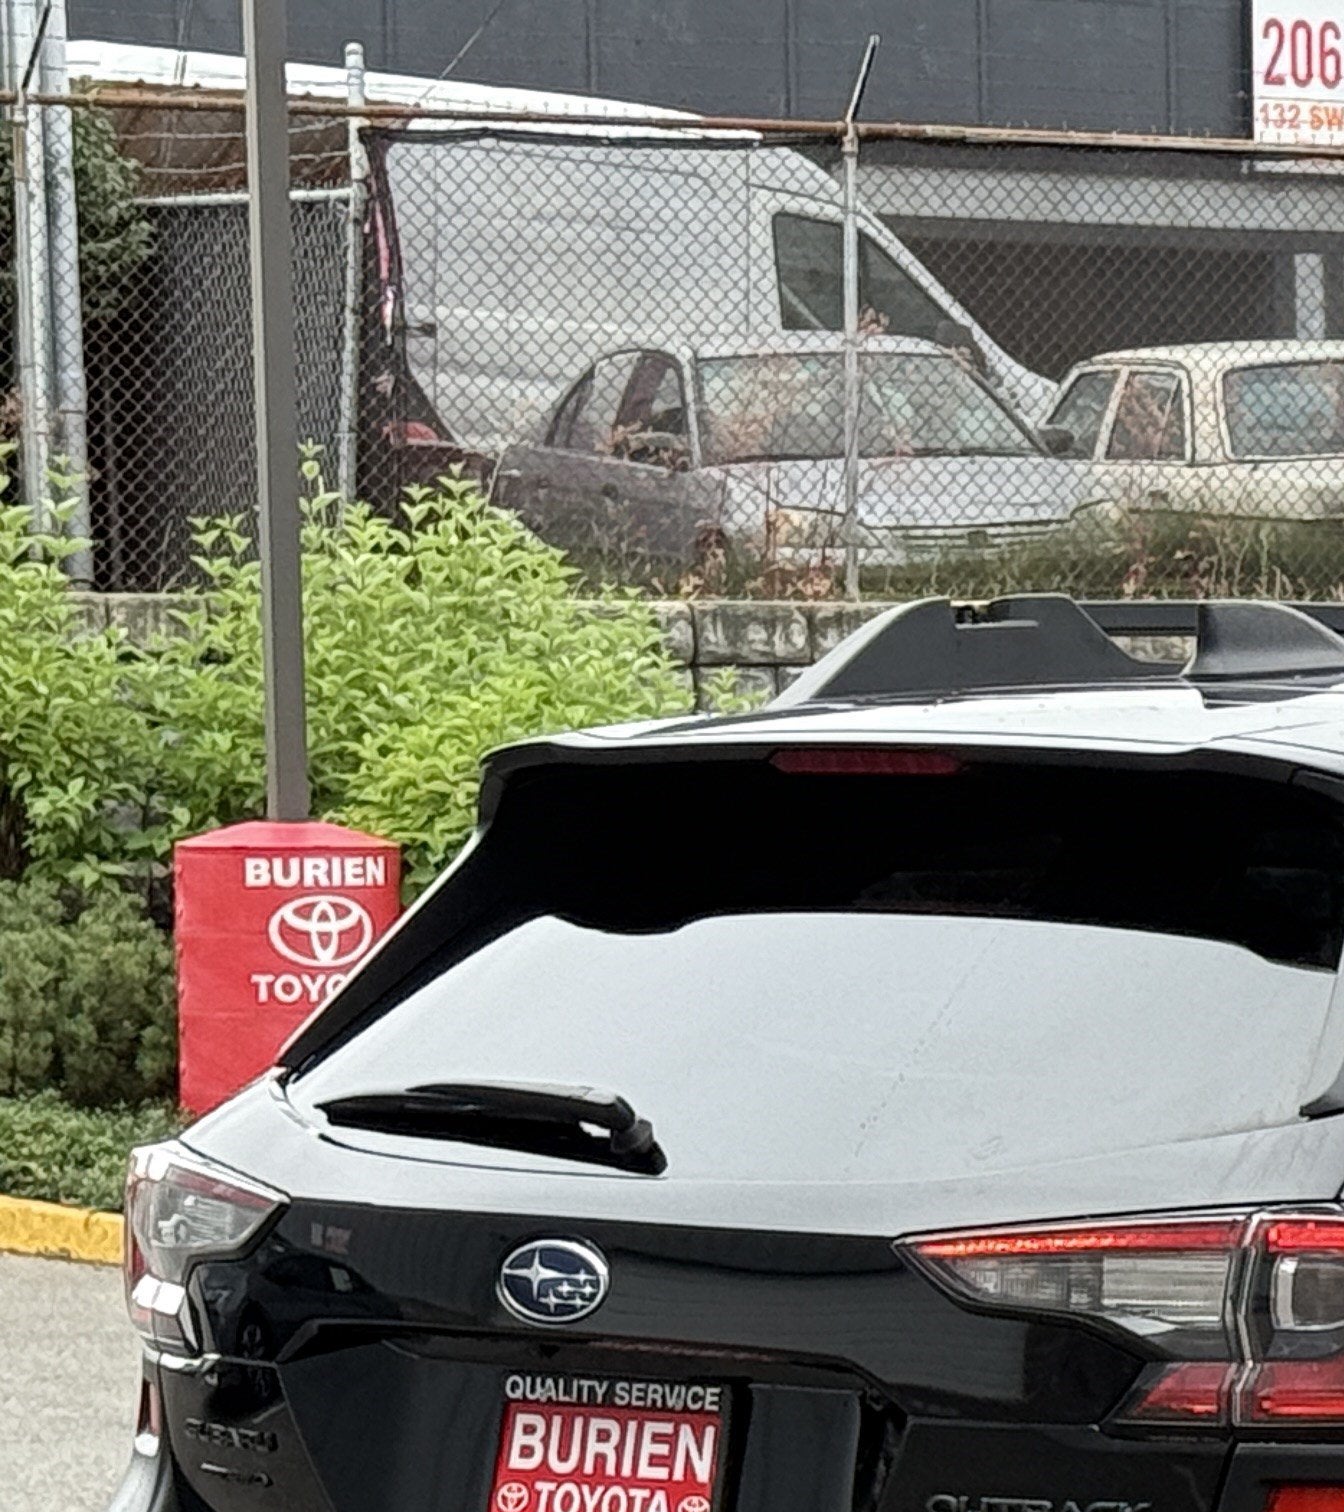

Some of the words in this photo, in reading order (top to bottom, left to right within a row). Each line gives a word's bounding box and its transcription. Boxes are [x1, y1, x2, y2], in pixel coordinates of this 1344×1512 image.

[1263, 18, 1342, 89] 206
[1259, 103, 1301, 130] 132
[1309, 105, 1344, 133] SW
[244, 855, 386, 888] BURIEN
[505, 1375, 608, 1403] QUALITY
[614, 1381, 721, 1411] SERVICE
[508, 1412, 716, 1484] BURIEN
